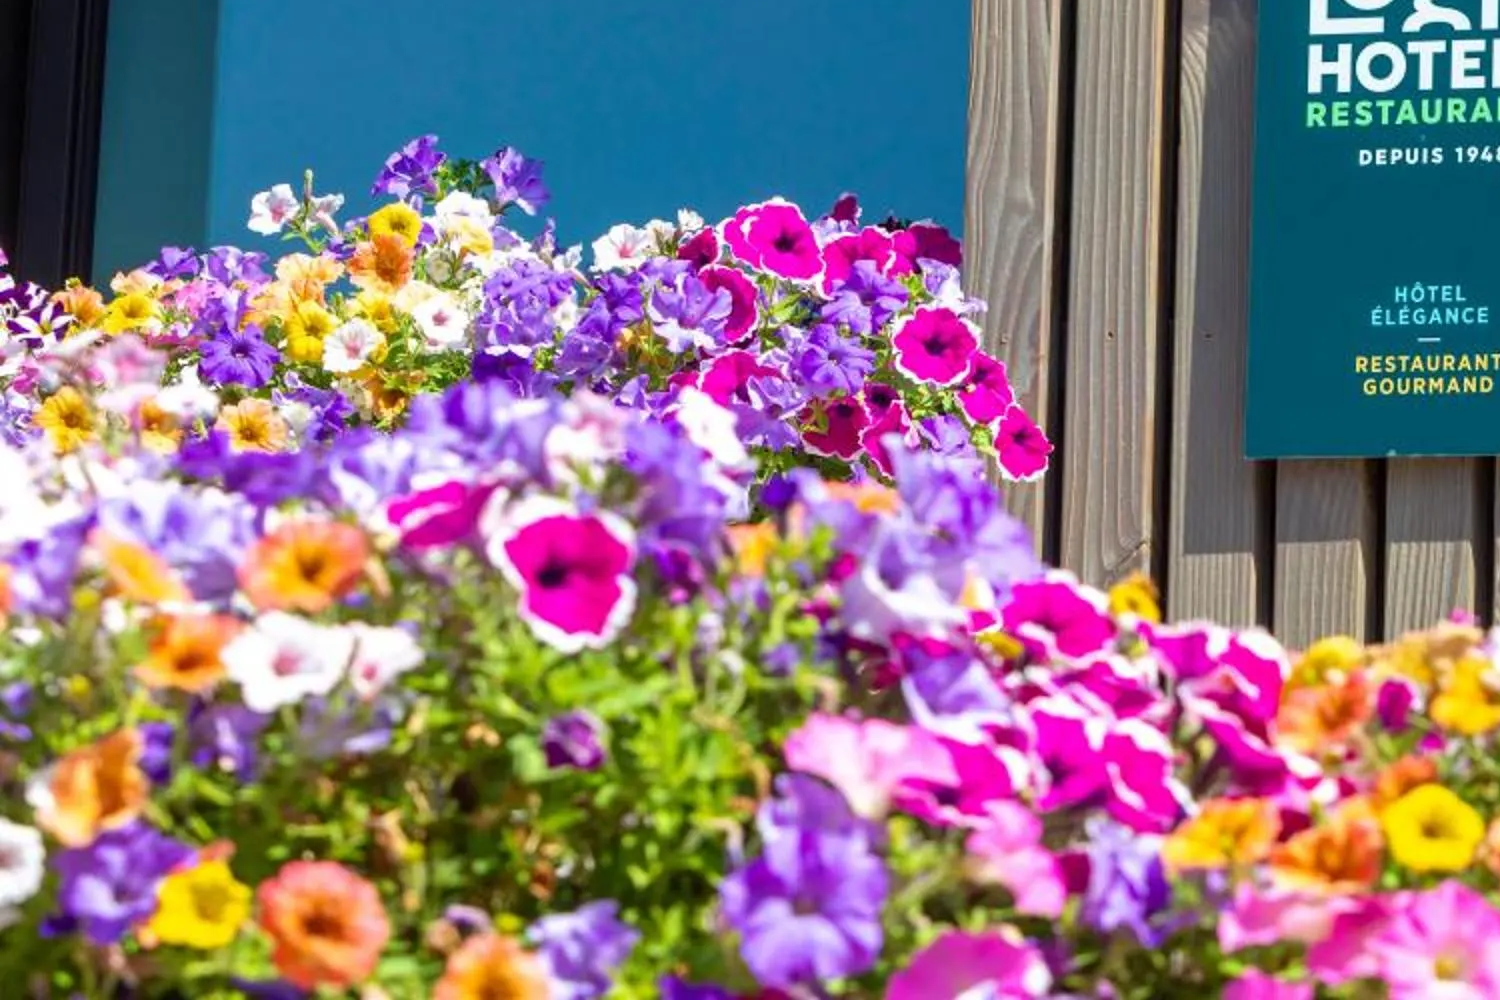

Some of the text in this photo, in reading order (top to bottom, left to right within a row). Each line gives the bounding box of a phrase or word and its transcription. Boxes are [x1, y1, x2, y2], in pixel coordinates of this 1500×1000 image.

[1358, 147, 1444, 166] DEPUIS
[1394, 281, 1467, 303] HÔTEL
[1371, 304, 1490, 326] ÉLÉGANCE
[1362, 376, 1494, 395] GOURMAND
